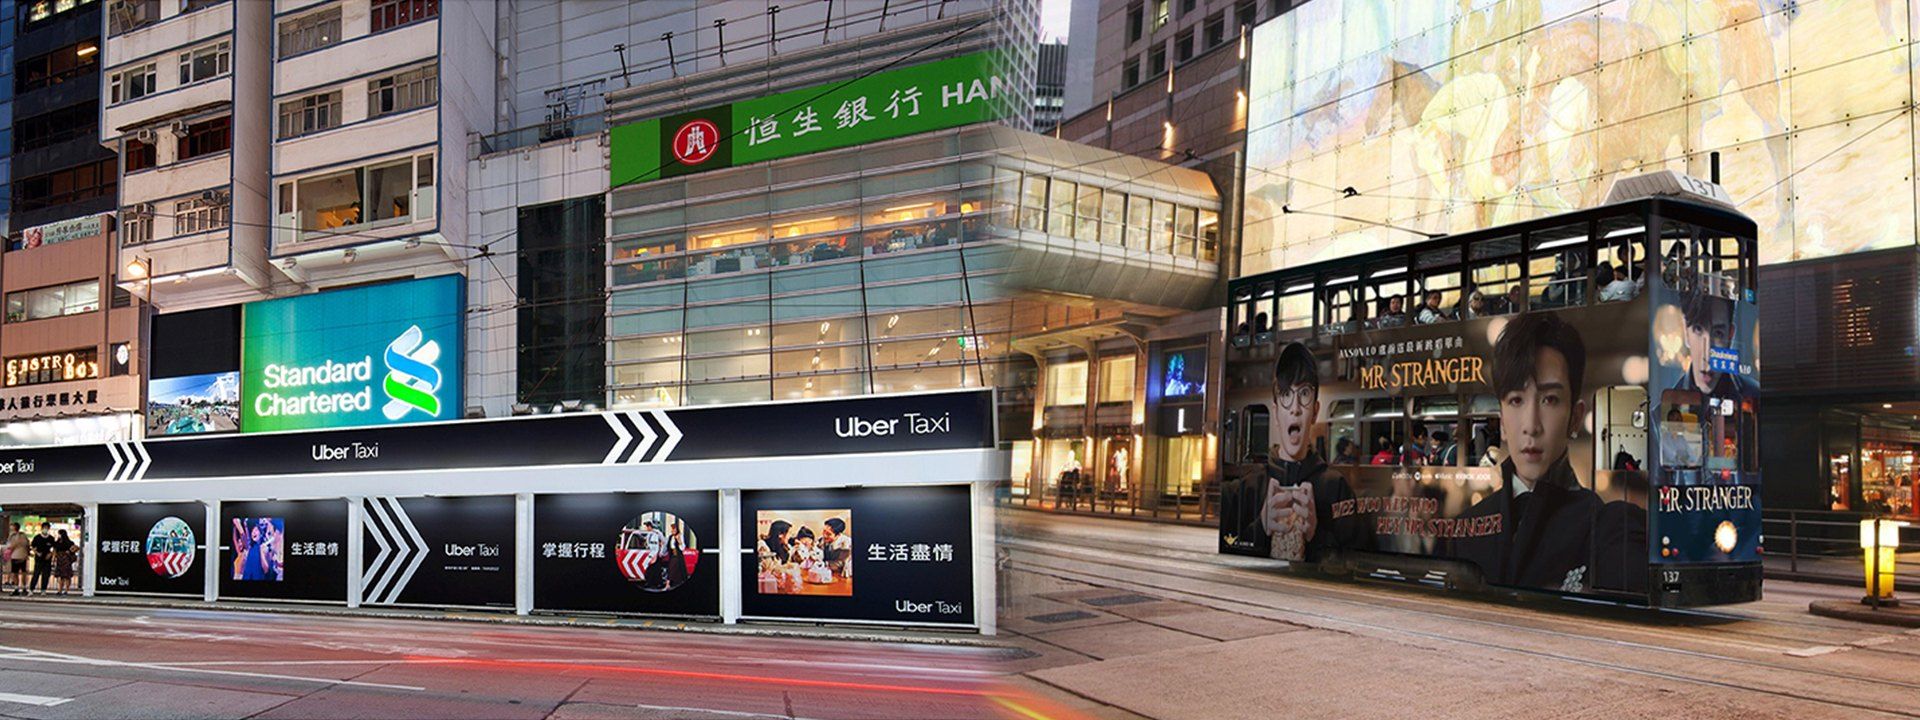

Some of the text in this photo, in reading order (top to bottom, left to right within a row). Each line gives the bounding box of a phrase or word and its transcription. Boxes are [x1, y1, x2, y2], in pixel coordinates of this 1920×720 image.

[743, 86, 923, 146] 恒生銀行
[1683, 175, 1716, 197] 137
[263, 355, 371, 388] Standard
[1360, 356, 1487, 390] MR. STRANGER
[254, 385, 371, 416] Chartered
[835, 412, 950, 438] Uber Taxi
[312, 442, 379, 460] Uber Taxi
[16, 459, 35, 473] Taxi
[1658, 485, 1754, 514] MR. STRANGER
[1427, 513, 1502, 538] STRANGER
[291, 541, 339, 556] 生活盡情
[445, 543, 500, 557] Uber Taxi
[542, 542, 606, 558] 掌握行程
[867, 543, 954, 561] 生活盡情
[99, 576, 117, 586] Uber
[1662, 571, 1680, 583] 137
[895, 599, 962, 614] Uber Taxi
